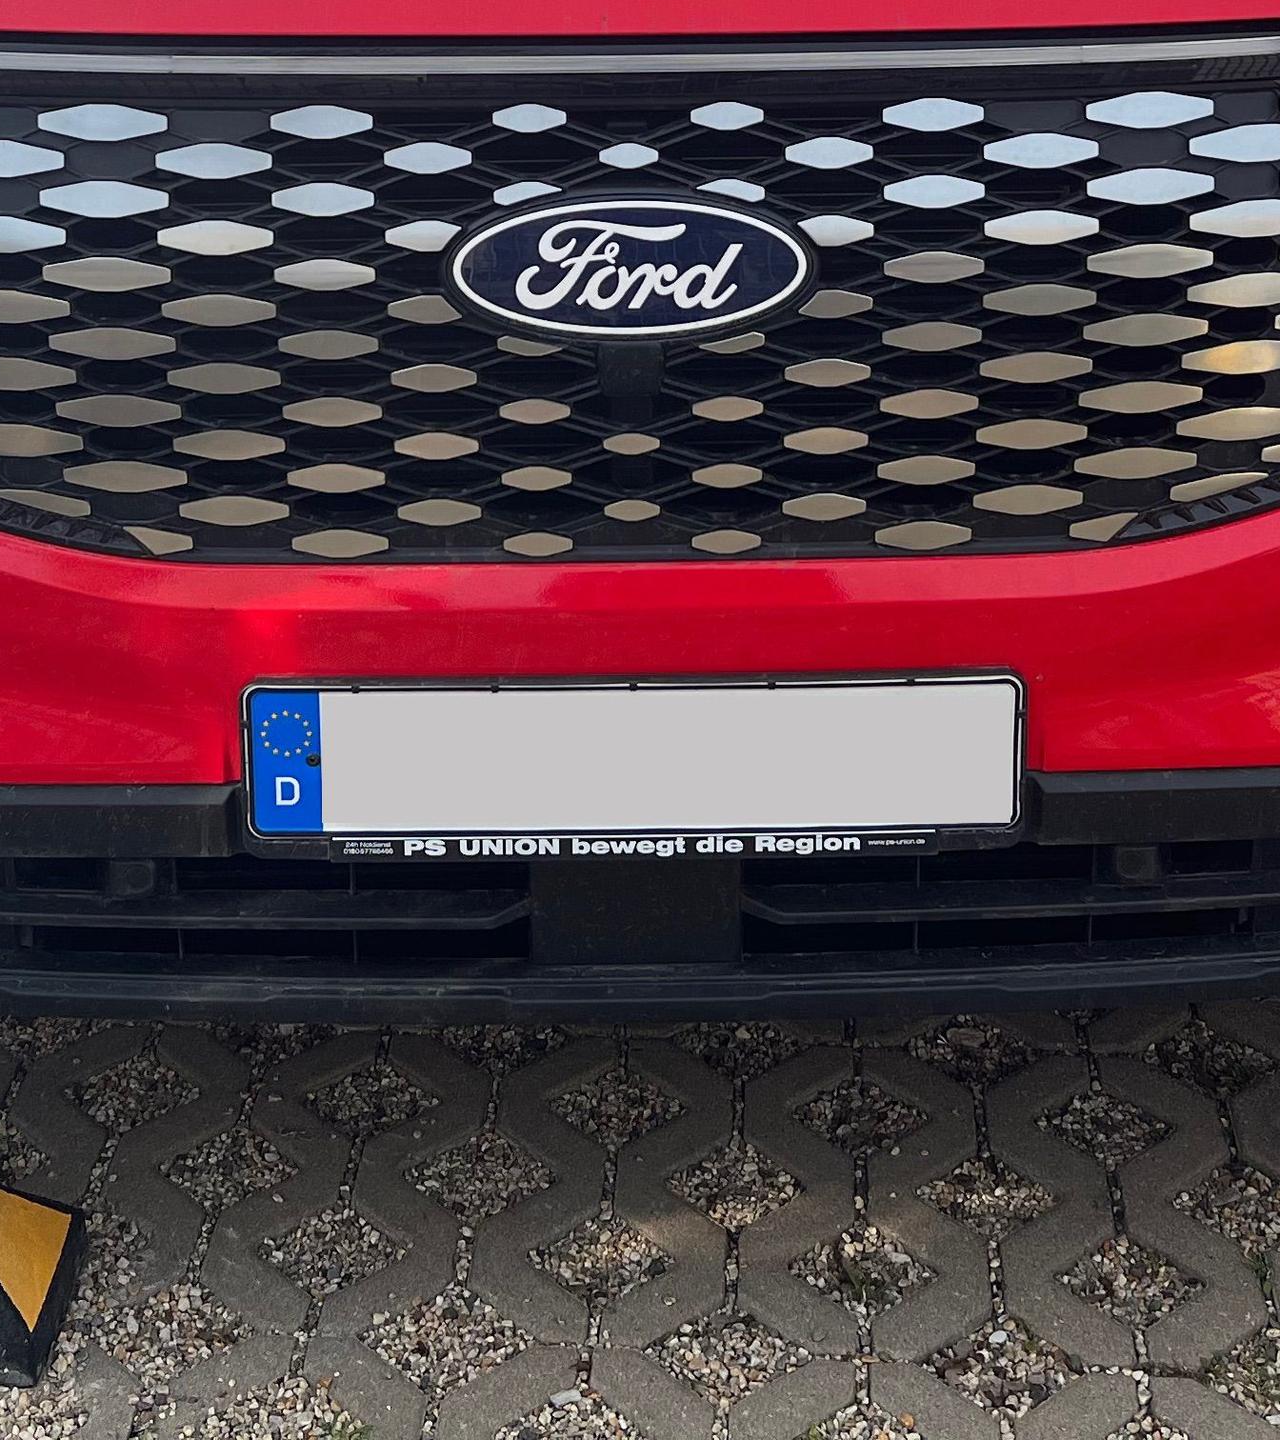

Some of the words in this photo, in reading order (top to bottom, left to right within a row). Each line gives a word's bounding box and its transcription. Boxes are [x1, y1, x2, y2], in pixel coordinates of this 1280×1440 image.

[515, 220, 744, 310] Ford
[275, 776, 300, 806] D
[404, 839, 447, 856] PS
[459, 838, 560, 856] UNION
[572, 836, 687, 857] bewegt
[695, 835, 744, 854] die
[754, 833, 862, 855] Region
